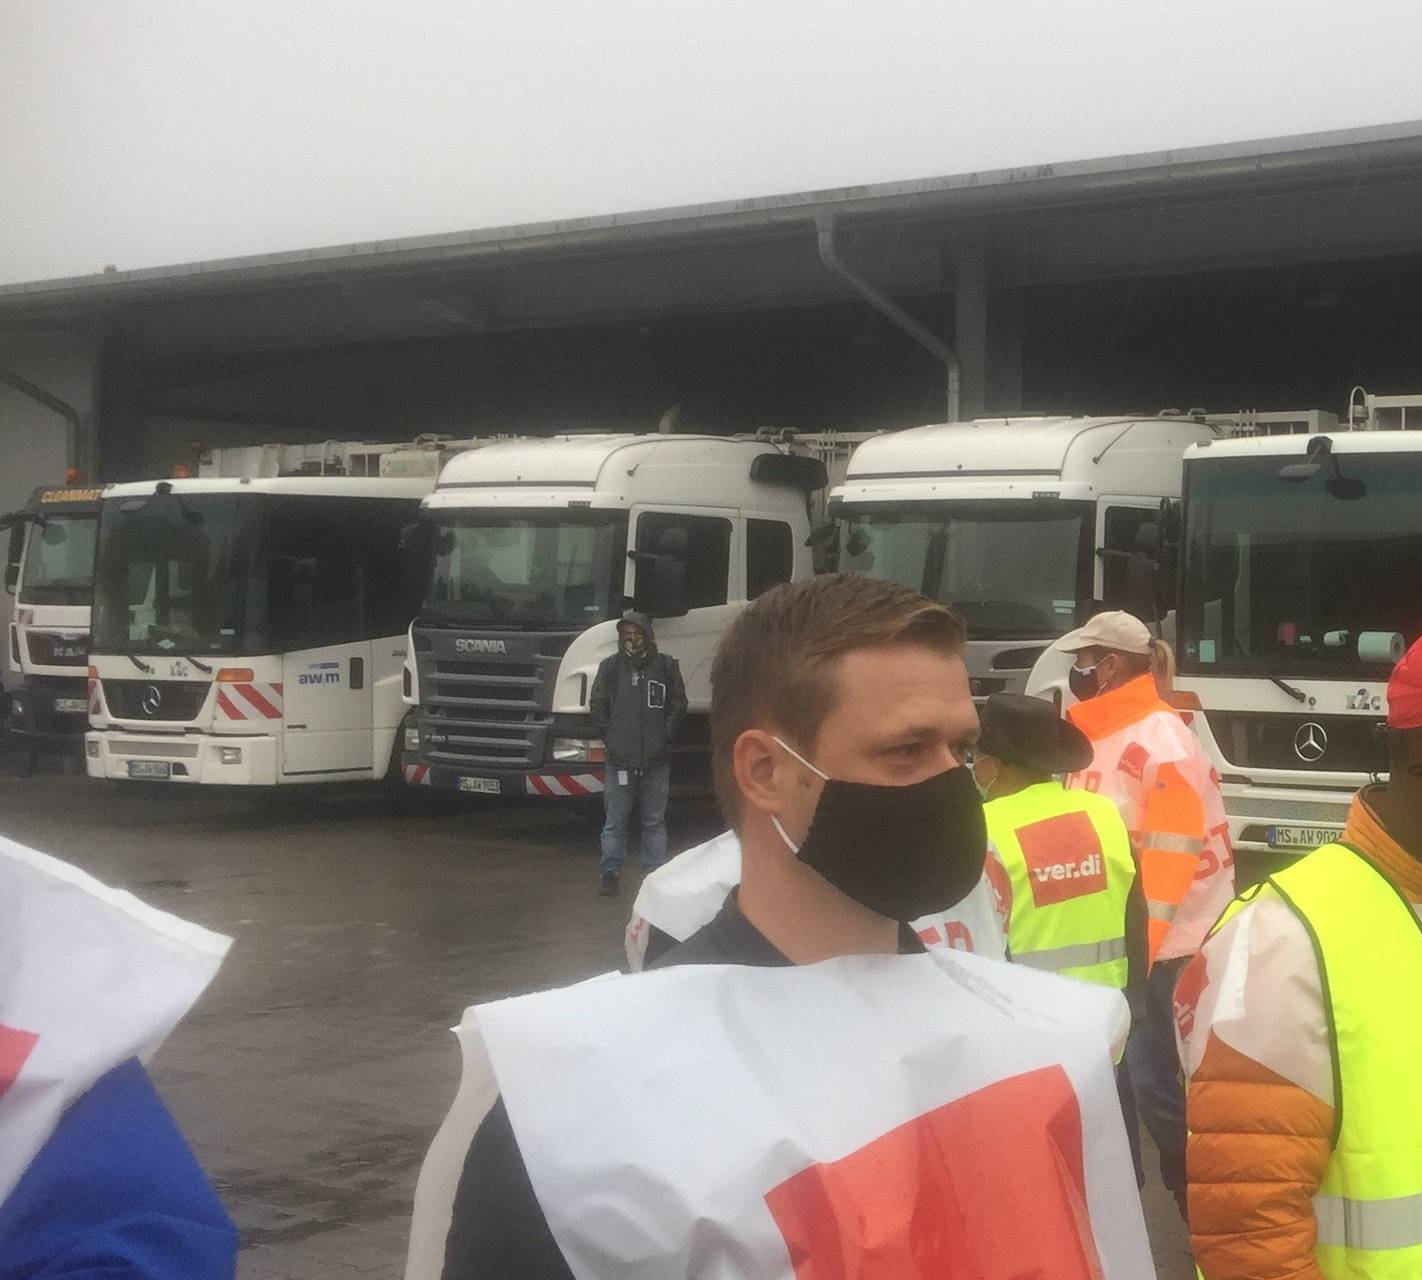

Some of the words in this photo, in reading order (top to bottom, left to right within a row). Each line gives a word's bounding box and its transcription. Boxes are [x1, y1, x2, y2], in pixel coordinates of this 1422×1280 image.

[455, 638, 506, 653] SCANIA
[299, 672, 340, 685] awm
[1033, 853, 1101, 882] ver.di
